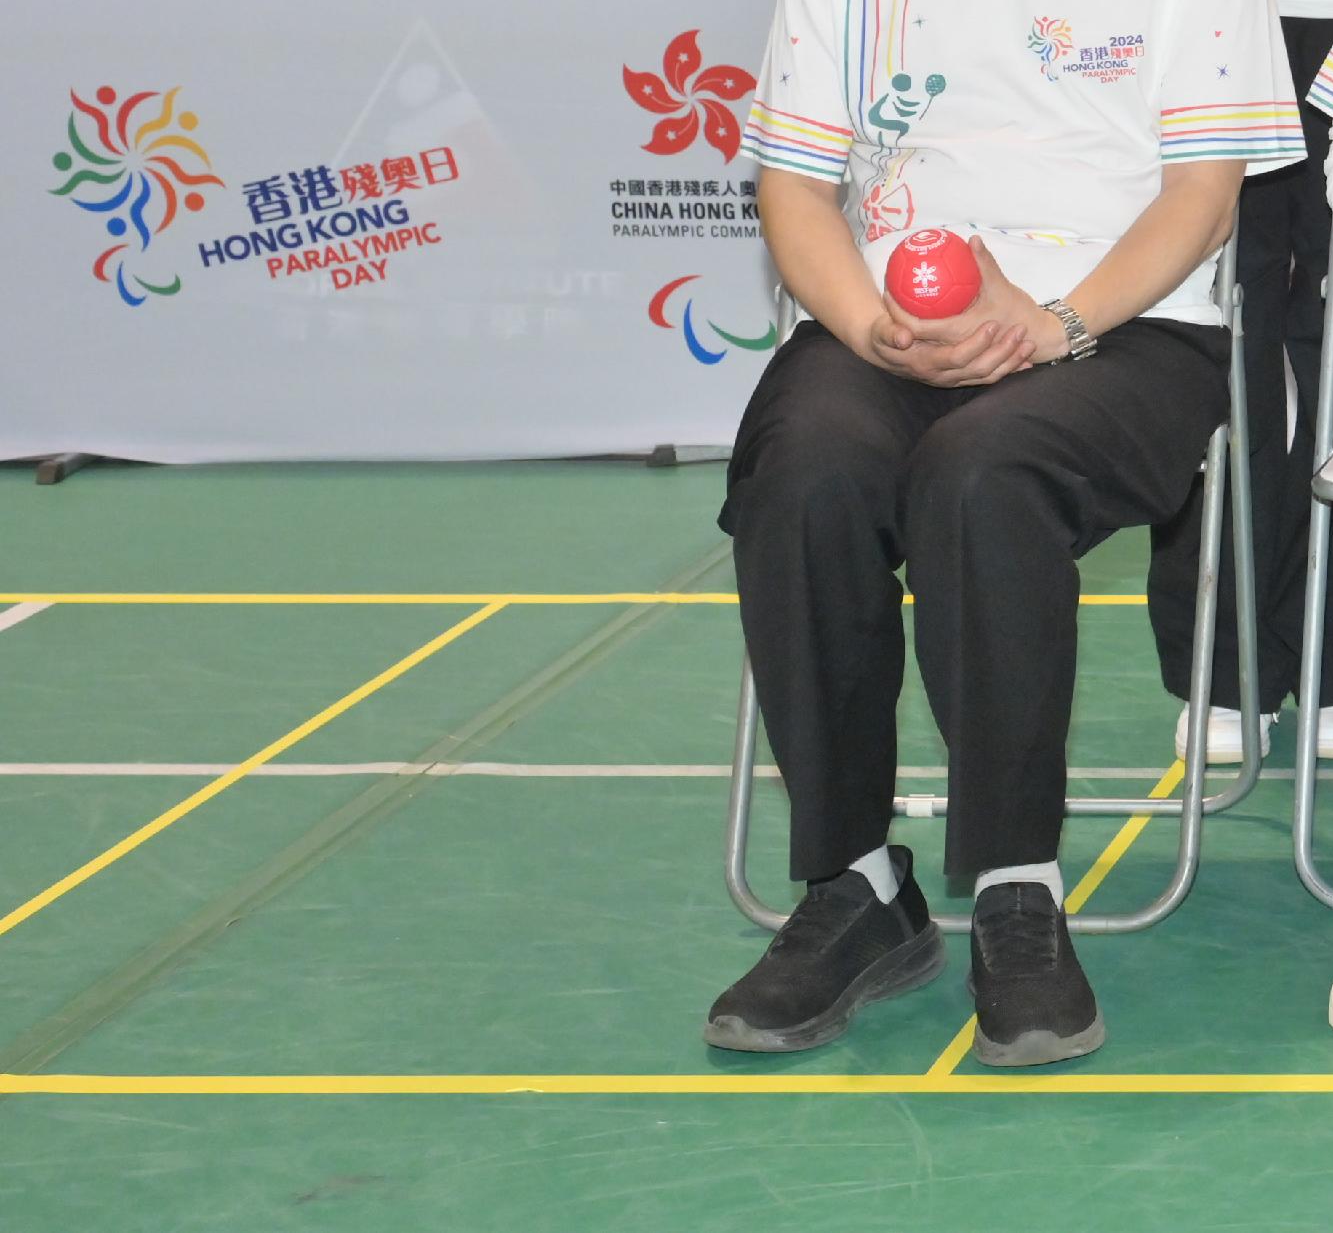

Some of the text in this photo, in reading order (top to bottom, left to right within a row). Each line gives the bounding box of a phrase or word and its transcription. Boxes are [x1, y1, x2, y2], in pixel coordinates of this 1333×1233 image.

[1109, 35, 1144, 47] 2024
[1063, 59, 1129, 73] HONG KONG
[1082, 68, 1137, 78] PARALYMPIC
[1101, 76, 1120, 84] DAY
[242, 147, 459, 225] 香港殘奧日
[611, 202, 673, 219] CHINA
[678, 202, 735, 220] HONG
[198, 199, 410, 267] HONG KONG
[613, 224, 704, 238] PARALYMPIC
[266, 223, 442, 279] PARALYMPIC
[331, 259, 387, 290] DAY
